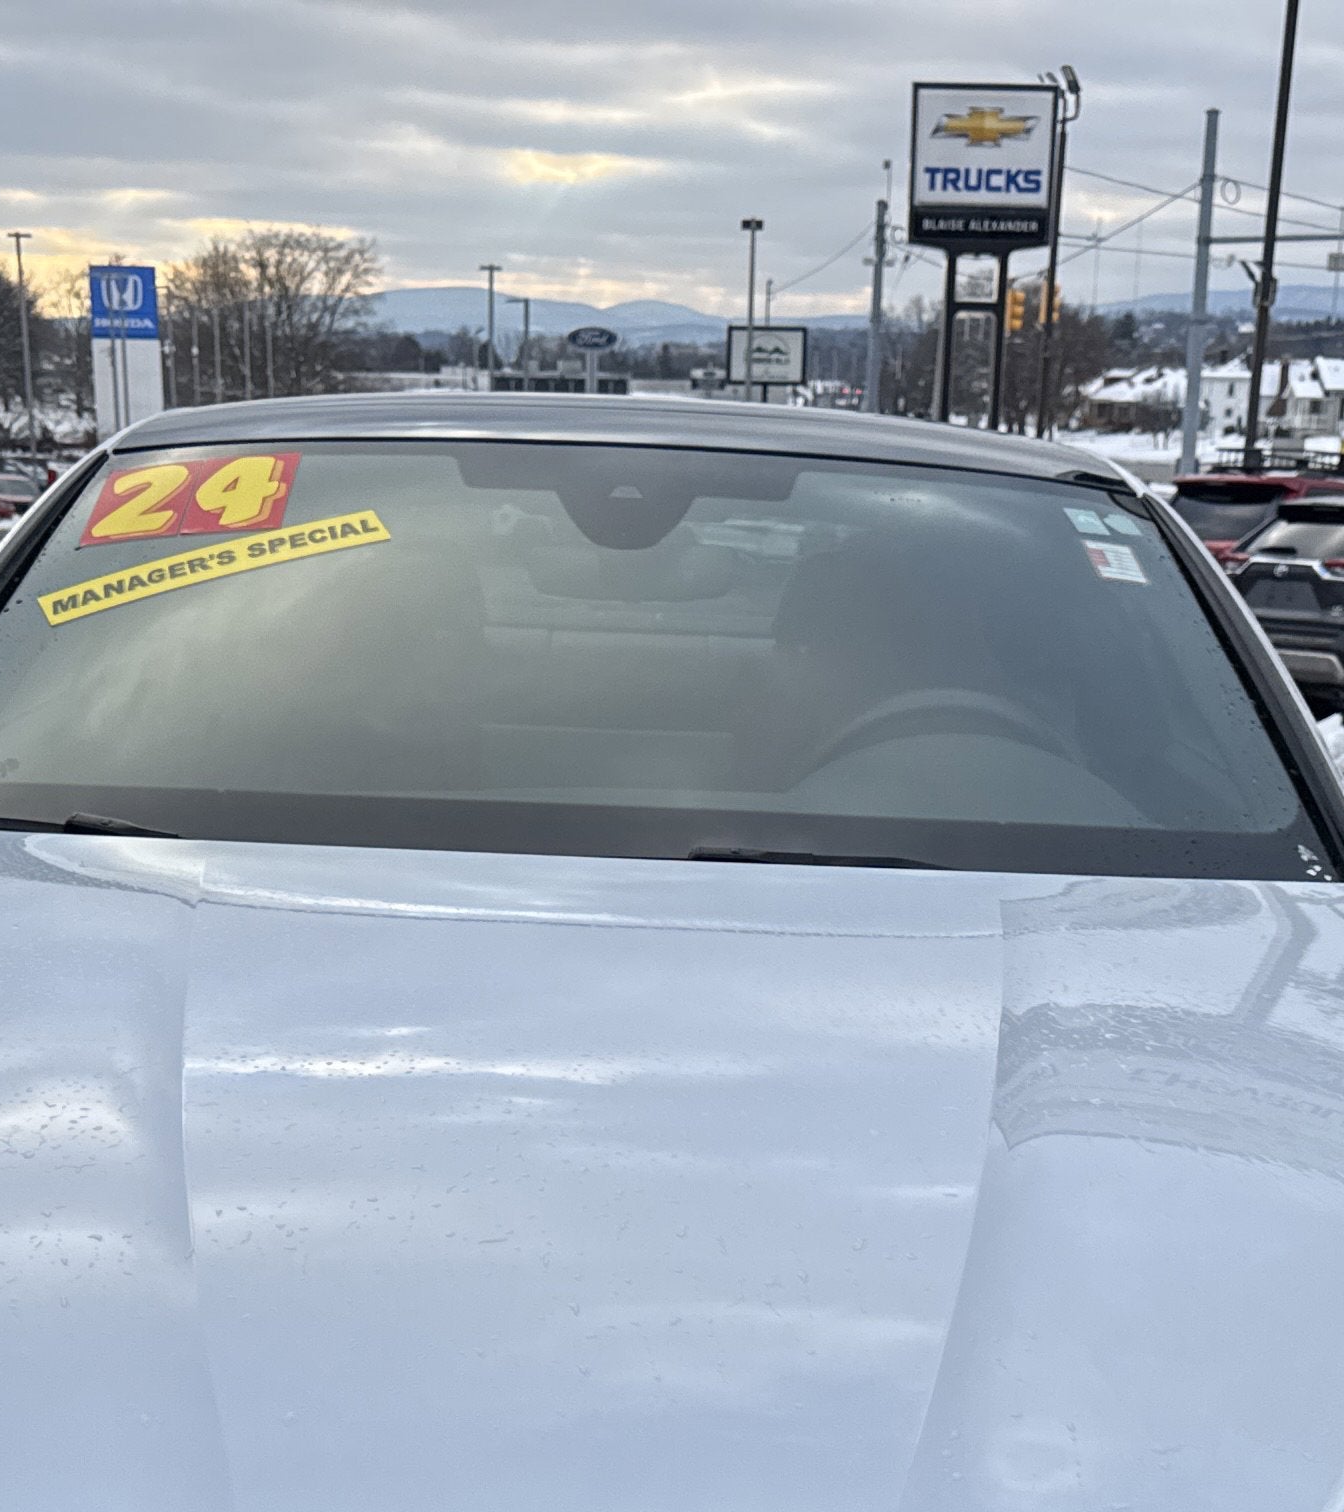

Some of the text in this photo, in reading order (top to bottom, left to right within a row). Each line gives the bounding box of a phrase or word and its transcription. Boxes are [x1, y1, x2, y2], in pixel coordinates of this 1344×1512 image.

[923, 166, 1042, 194] TRUCKS
[921, 217, 1039, 233] BLAISE ALEXANDER
[94, 317, 156, 329] HONDA
[90, 456, 285, 539] 24
[51, 518, 380, 616] MANAGER'S SPECIAL
